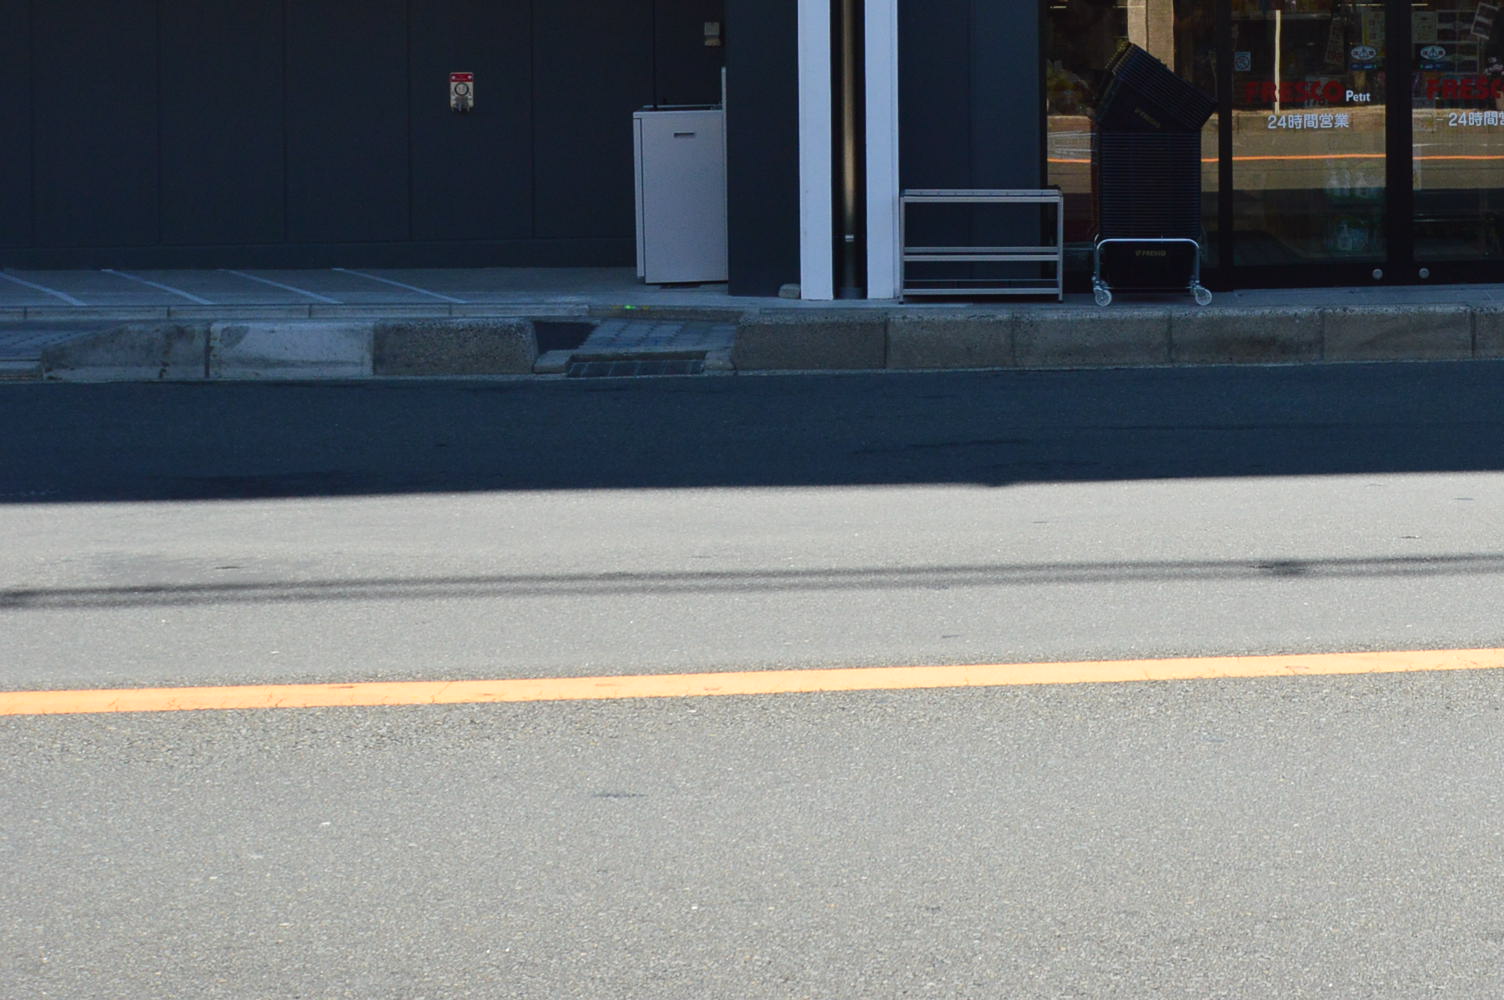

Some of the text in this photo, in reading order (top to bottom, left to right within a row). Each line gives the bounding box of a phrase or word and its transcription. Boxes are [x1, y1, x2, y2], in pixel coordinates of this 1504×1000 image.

[1244, 79, 1371, 103] FRESCO Petit
[1267, 113, 1349, 129] 24時間営業
